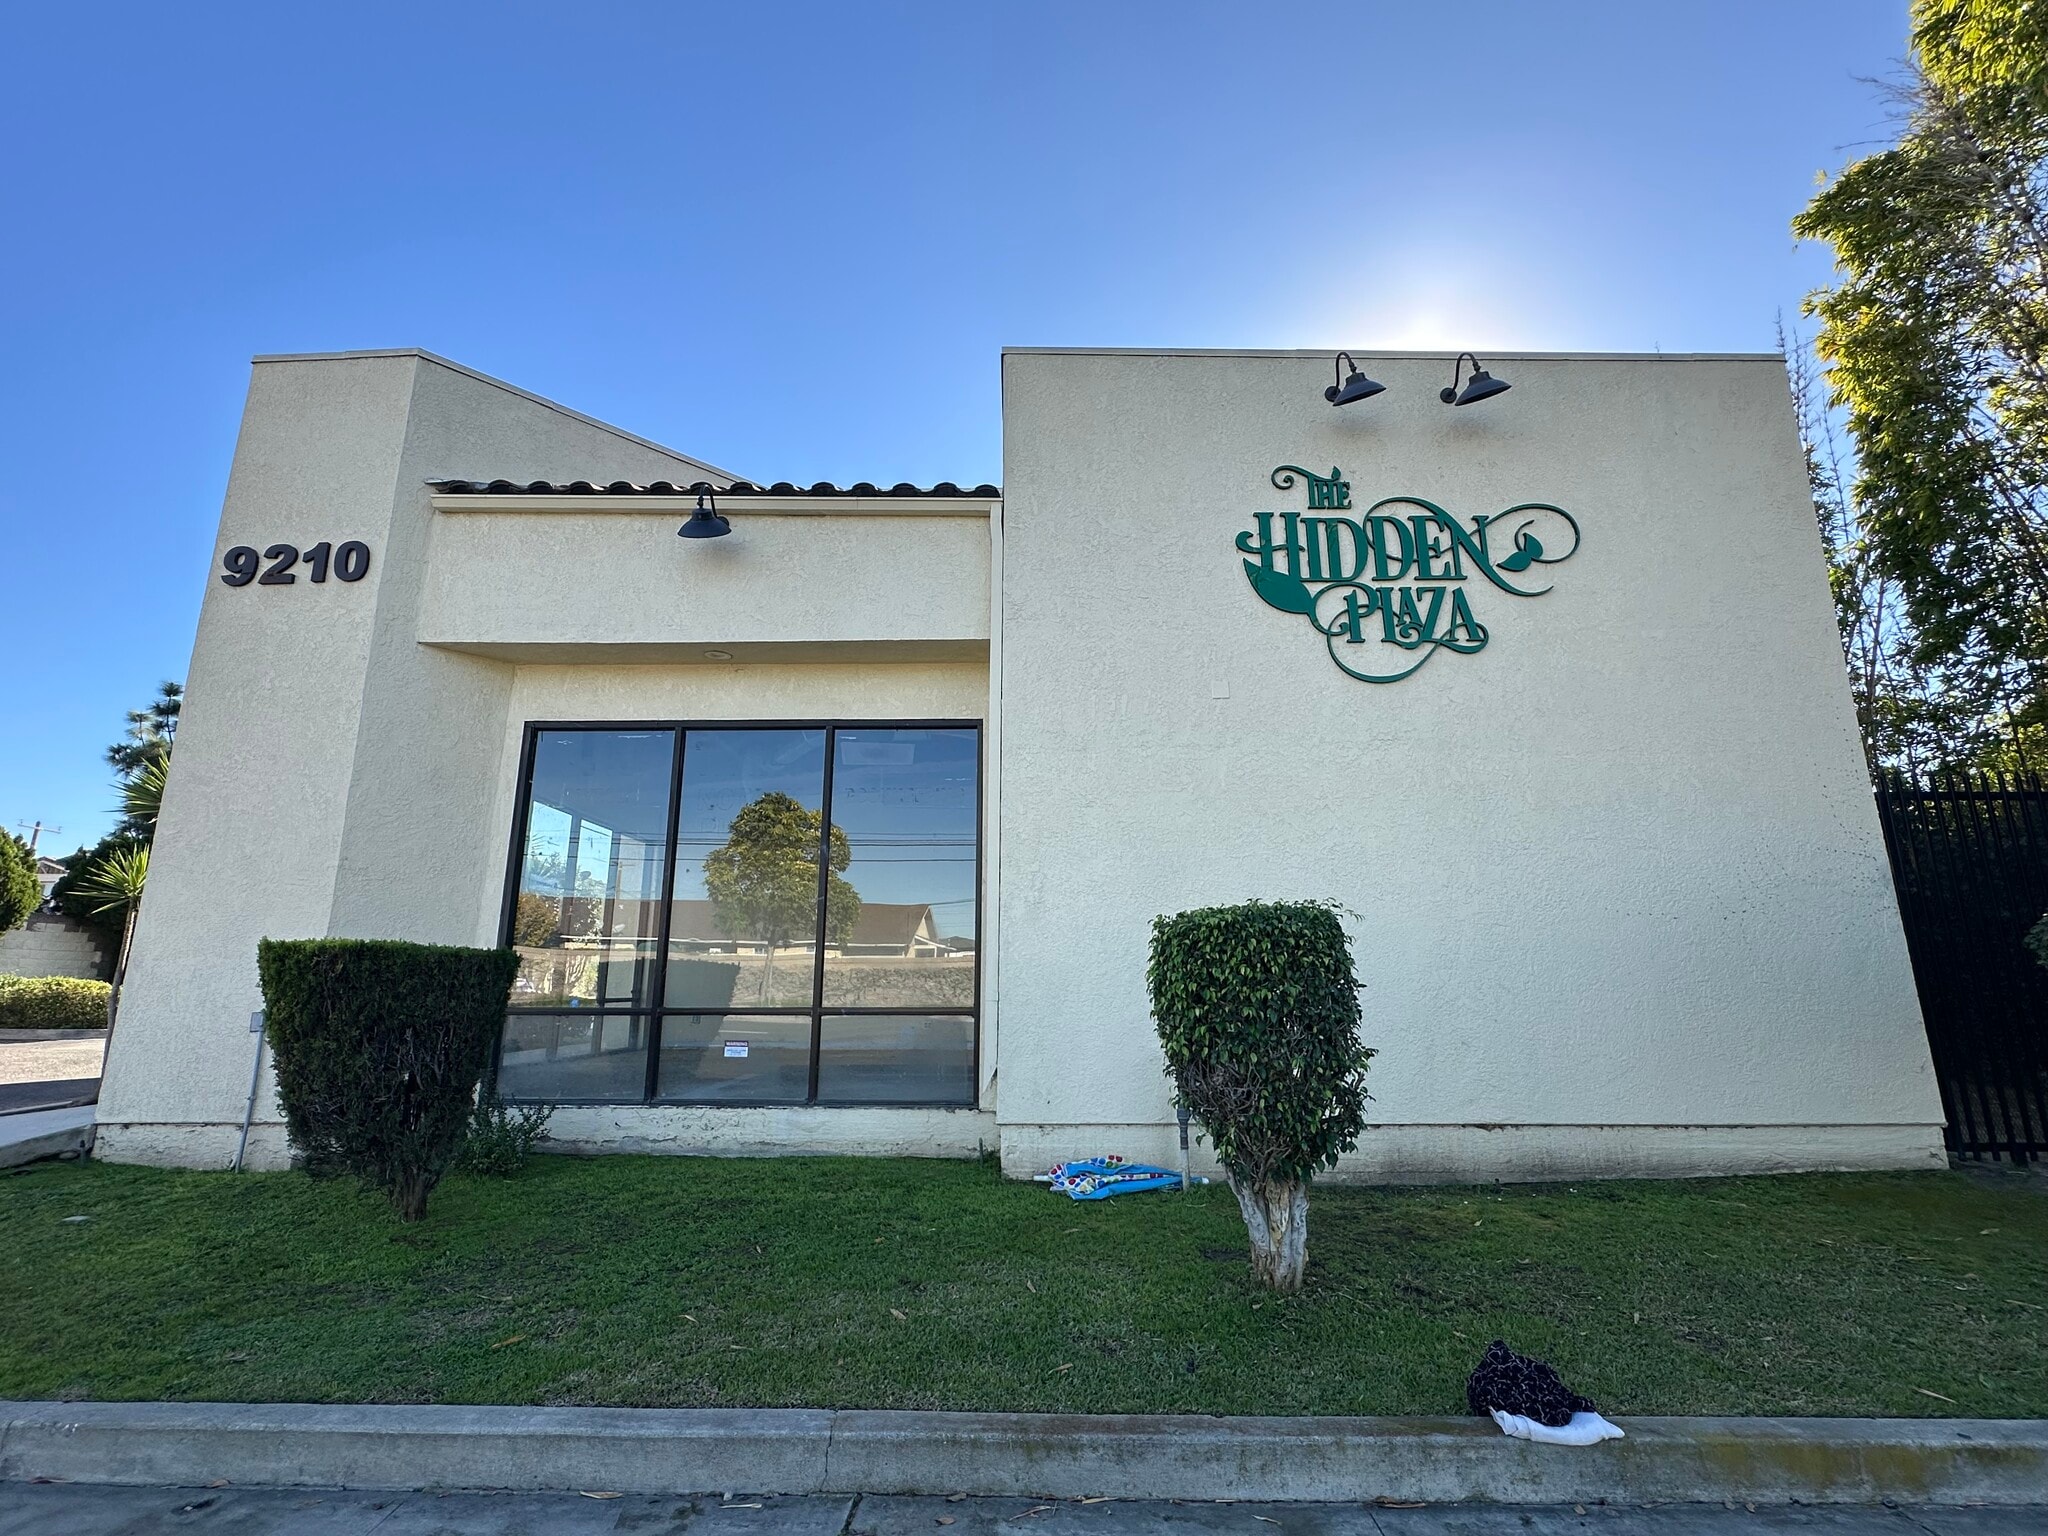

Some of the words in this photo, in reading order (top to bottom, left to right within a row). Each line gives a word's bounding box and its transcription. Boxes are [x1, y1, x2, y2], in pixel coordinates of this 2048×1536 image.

[1283, 465, 1353, 510] THE
[220, 540, 371, 587] 9210
[1236, 497, 1500, 588] HIDDEN
[1335, 582, 1490, 654] PLAZA
